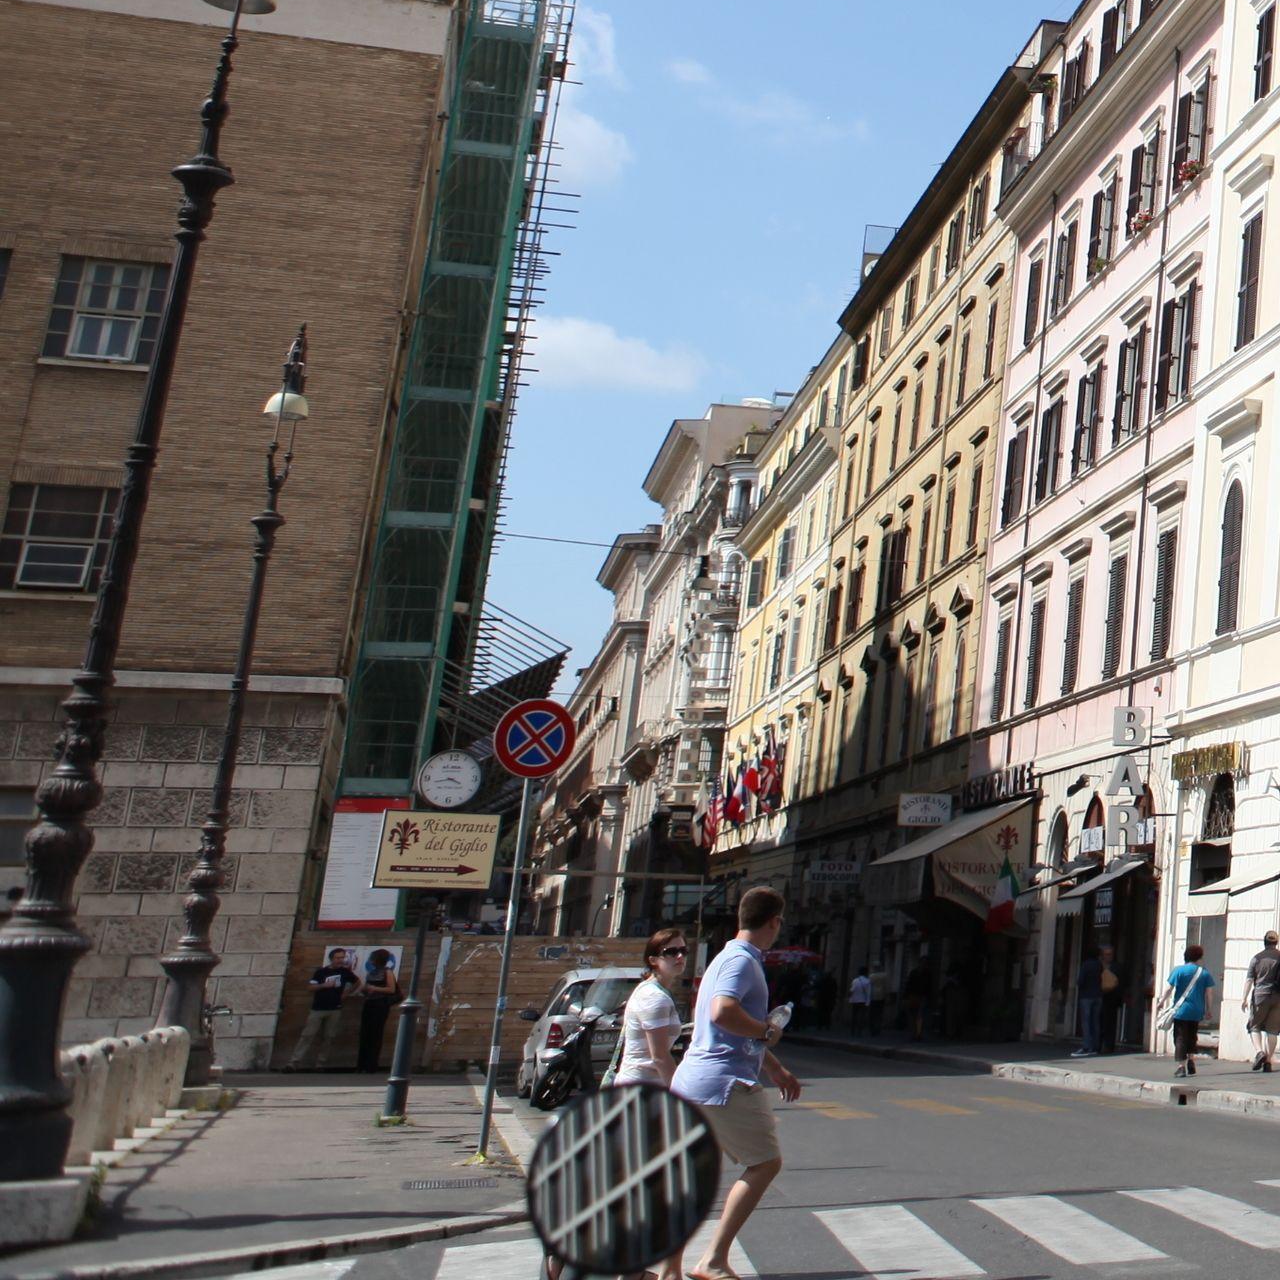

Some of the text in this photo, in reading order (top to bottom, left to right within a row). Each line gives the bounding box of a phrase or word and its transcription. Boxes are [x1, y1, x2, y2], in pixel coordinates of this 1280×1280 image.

[1105, 706, 1147, 848] BAR
[423, 818, 497, 835] Ristorante
[907, 815, 941, 824] GIGLIO
[424, 835, 488, 857] del Giglio
[820, 862, 854, 871] FOTO
[938, 861, 1025, 875] RISTORANE
